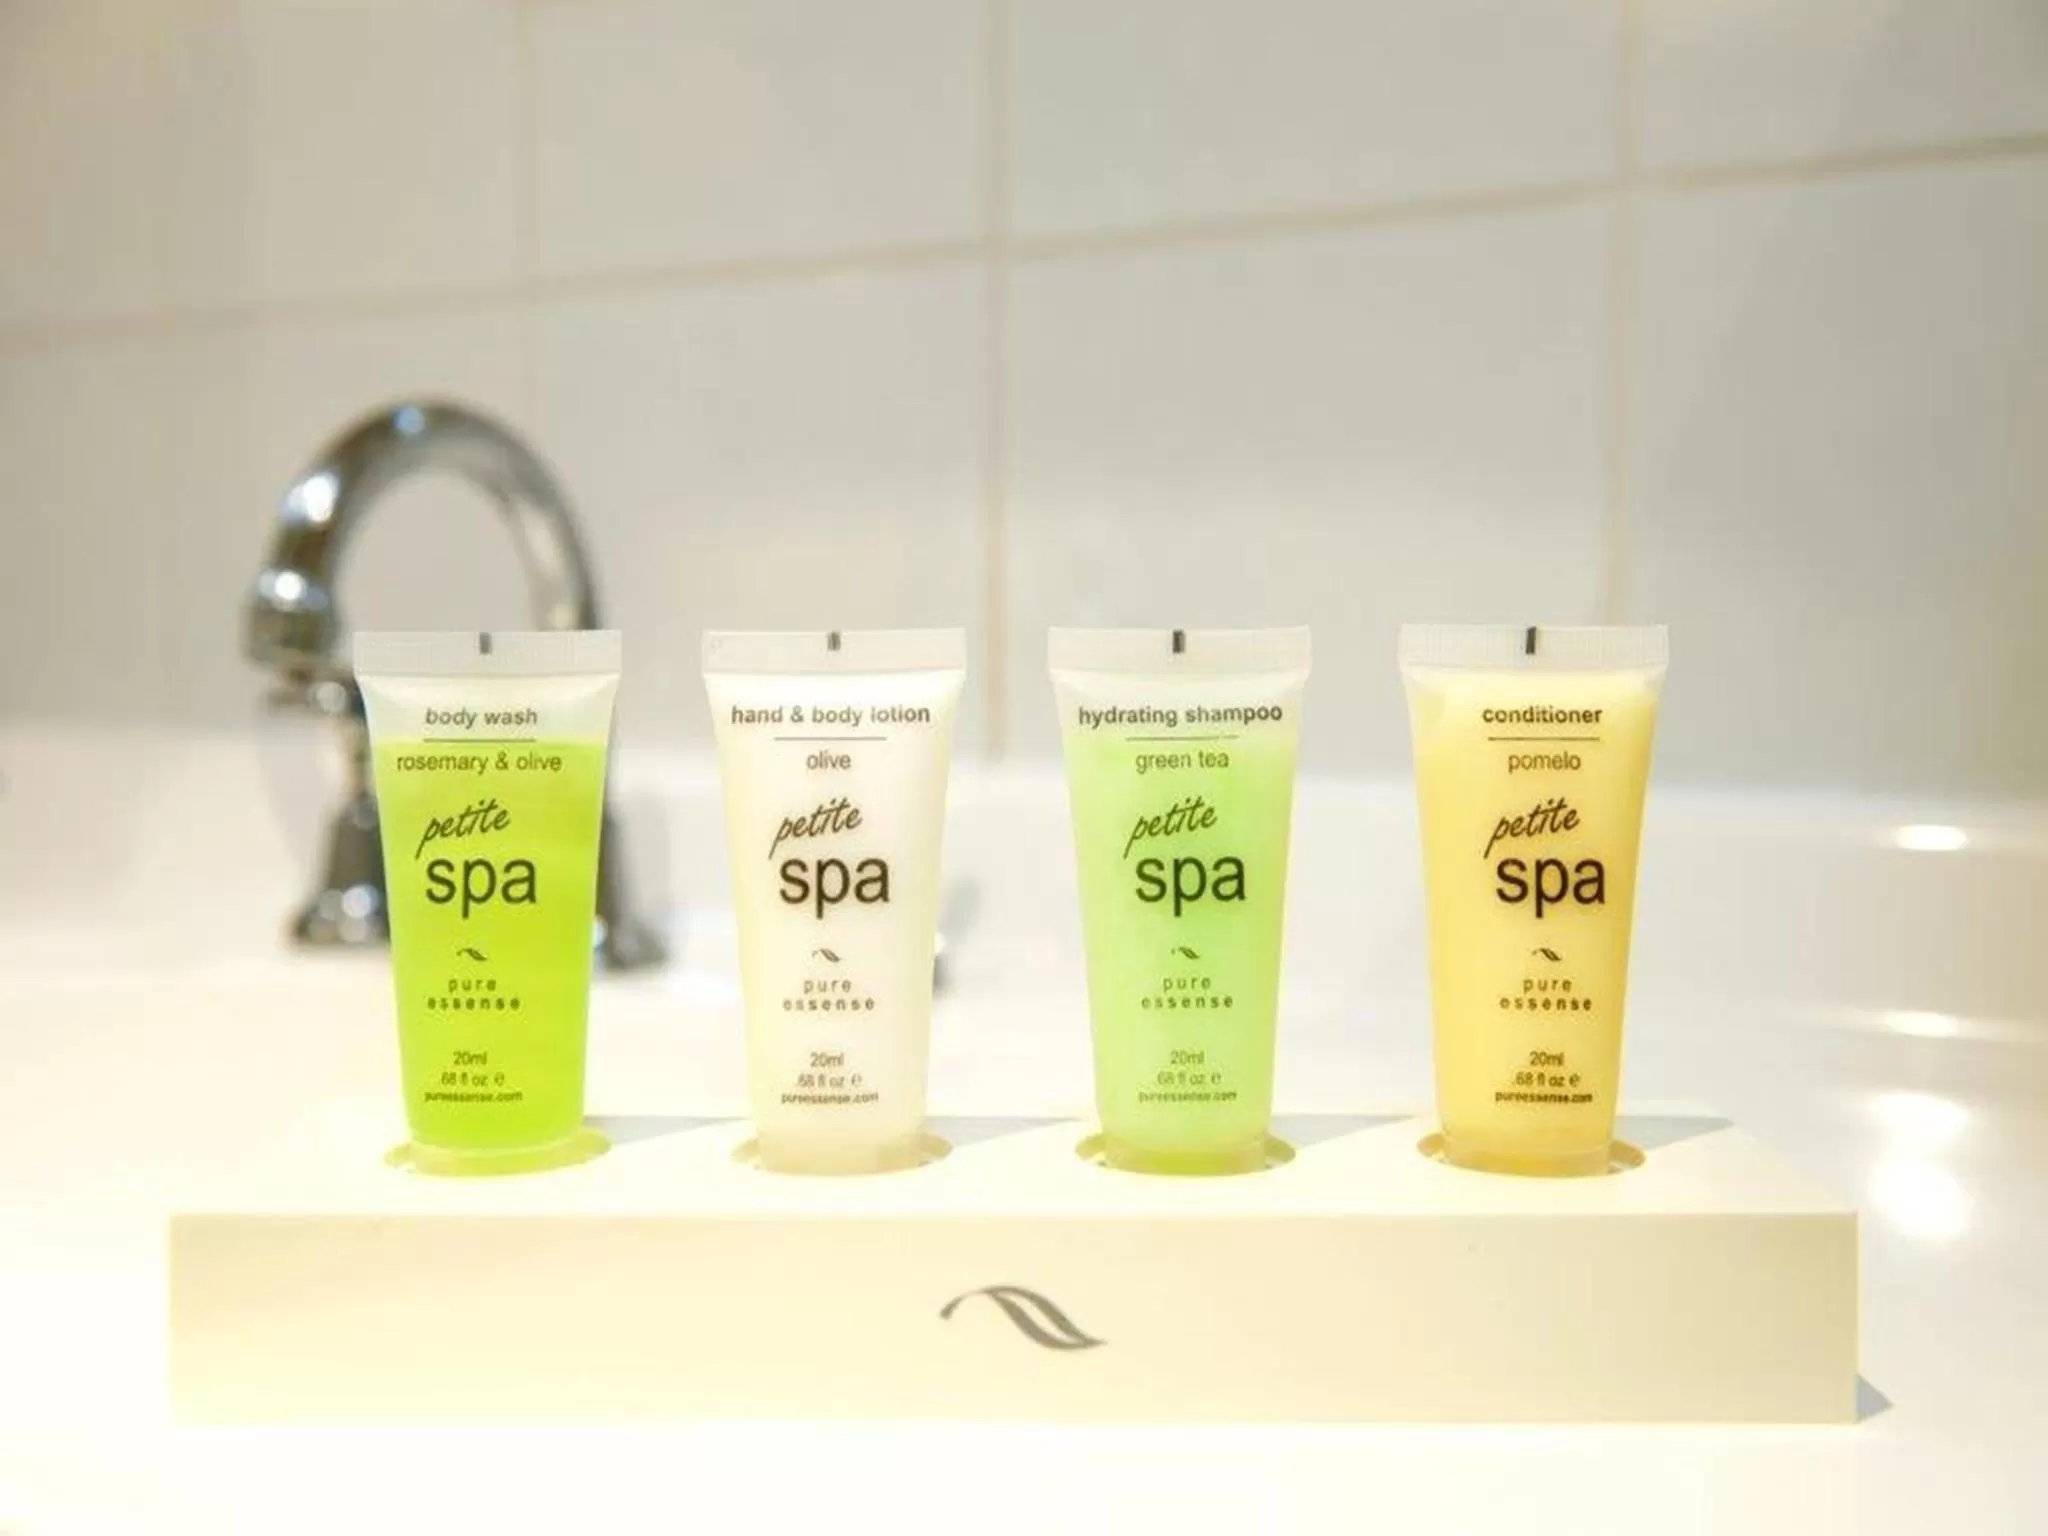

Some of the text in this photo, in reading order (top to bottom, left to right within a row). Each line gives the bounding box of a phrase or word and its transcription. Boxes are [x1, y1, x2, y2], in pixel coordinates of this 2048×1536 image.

[425, 707, 538, 729] body wash
[731, 704, 931, 727] hand & body lotion
[1078, 705, 1283, 728] hydrating shampoo
[1482, 705, 1602, 724] conditioner
[397, 752, 562, 775] rosemary & olive
[806, 749, 852, 771] olive
[1135, 750, 1230, 775] green tea
[1508, 750, 1582, 773] pomelo
[414, 799, 511, 860] petite
[768, 797, 863, 860] petite
[1123, 796, 1218, 860] petite
[1483, 797, 1580, 860] petite
[425, 857, 536, 919] spa
[779, 857, 890, 919] spa
[1135, 855, 1246, 917] spa
[1495, 857, 1606, 919] spa
[448, 978, 497, 994] pure
[803, 979, 852, 994] pure
[1163, 976, 1212, 993] pure
[1522, 978, 1572, 994] pure
[453, 1051, 488, 1066] 20ml
[809, 1051, 845, 1068] 20ml
[1170, 1049, 1205, 1066] 20ml
[1529, 1051, 1565, 1067] 20ml
